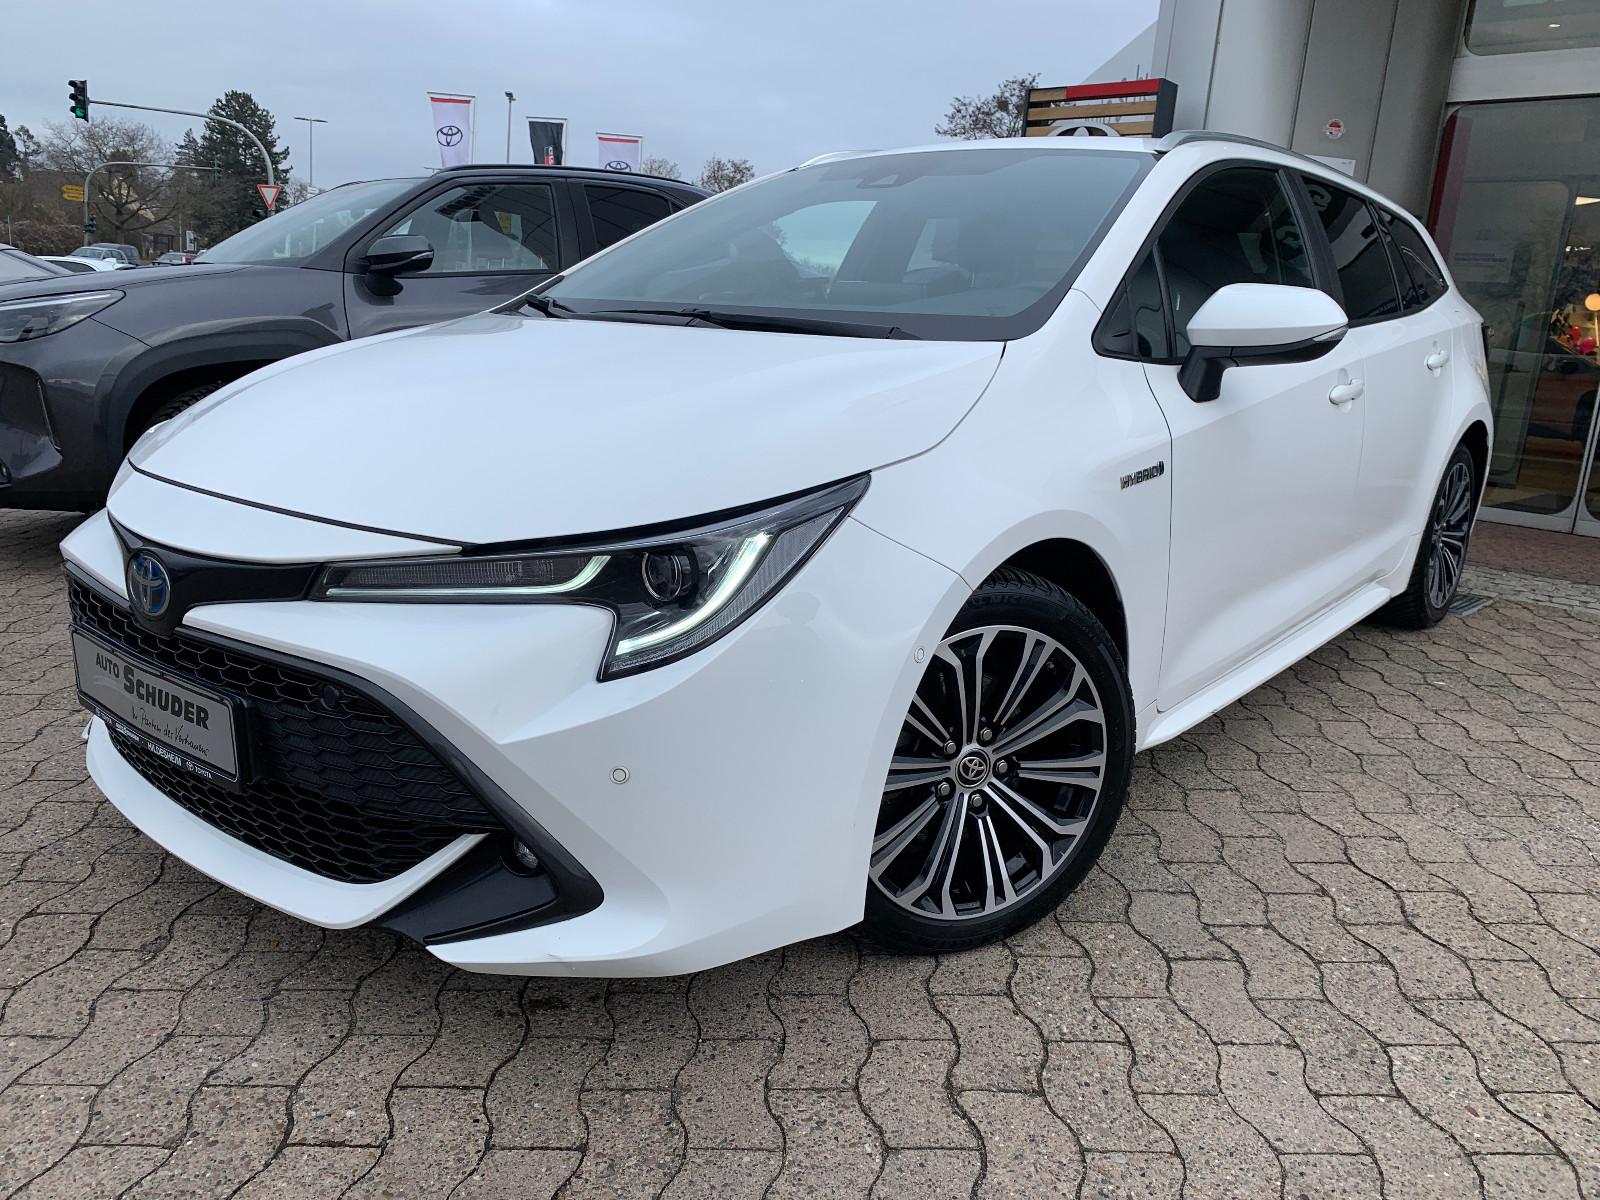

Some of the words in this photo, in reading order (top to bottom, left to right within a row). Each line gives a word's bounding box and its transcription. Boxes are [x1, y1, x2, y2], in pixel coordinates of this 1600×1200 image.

[1120, 461, 1164, 490] HYBRID
[95, 652, 120, 679] AUTO
[194, 765, 213, 780] TOYOTA
